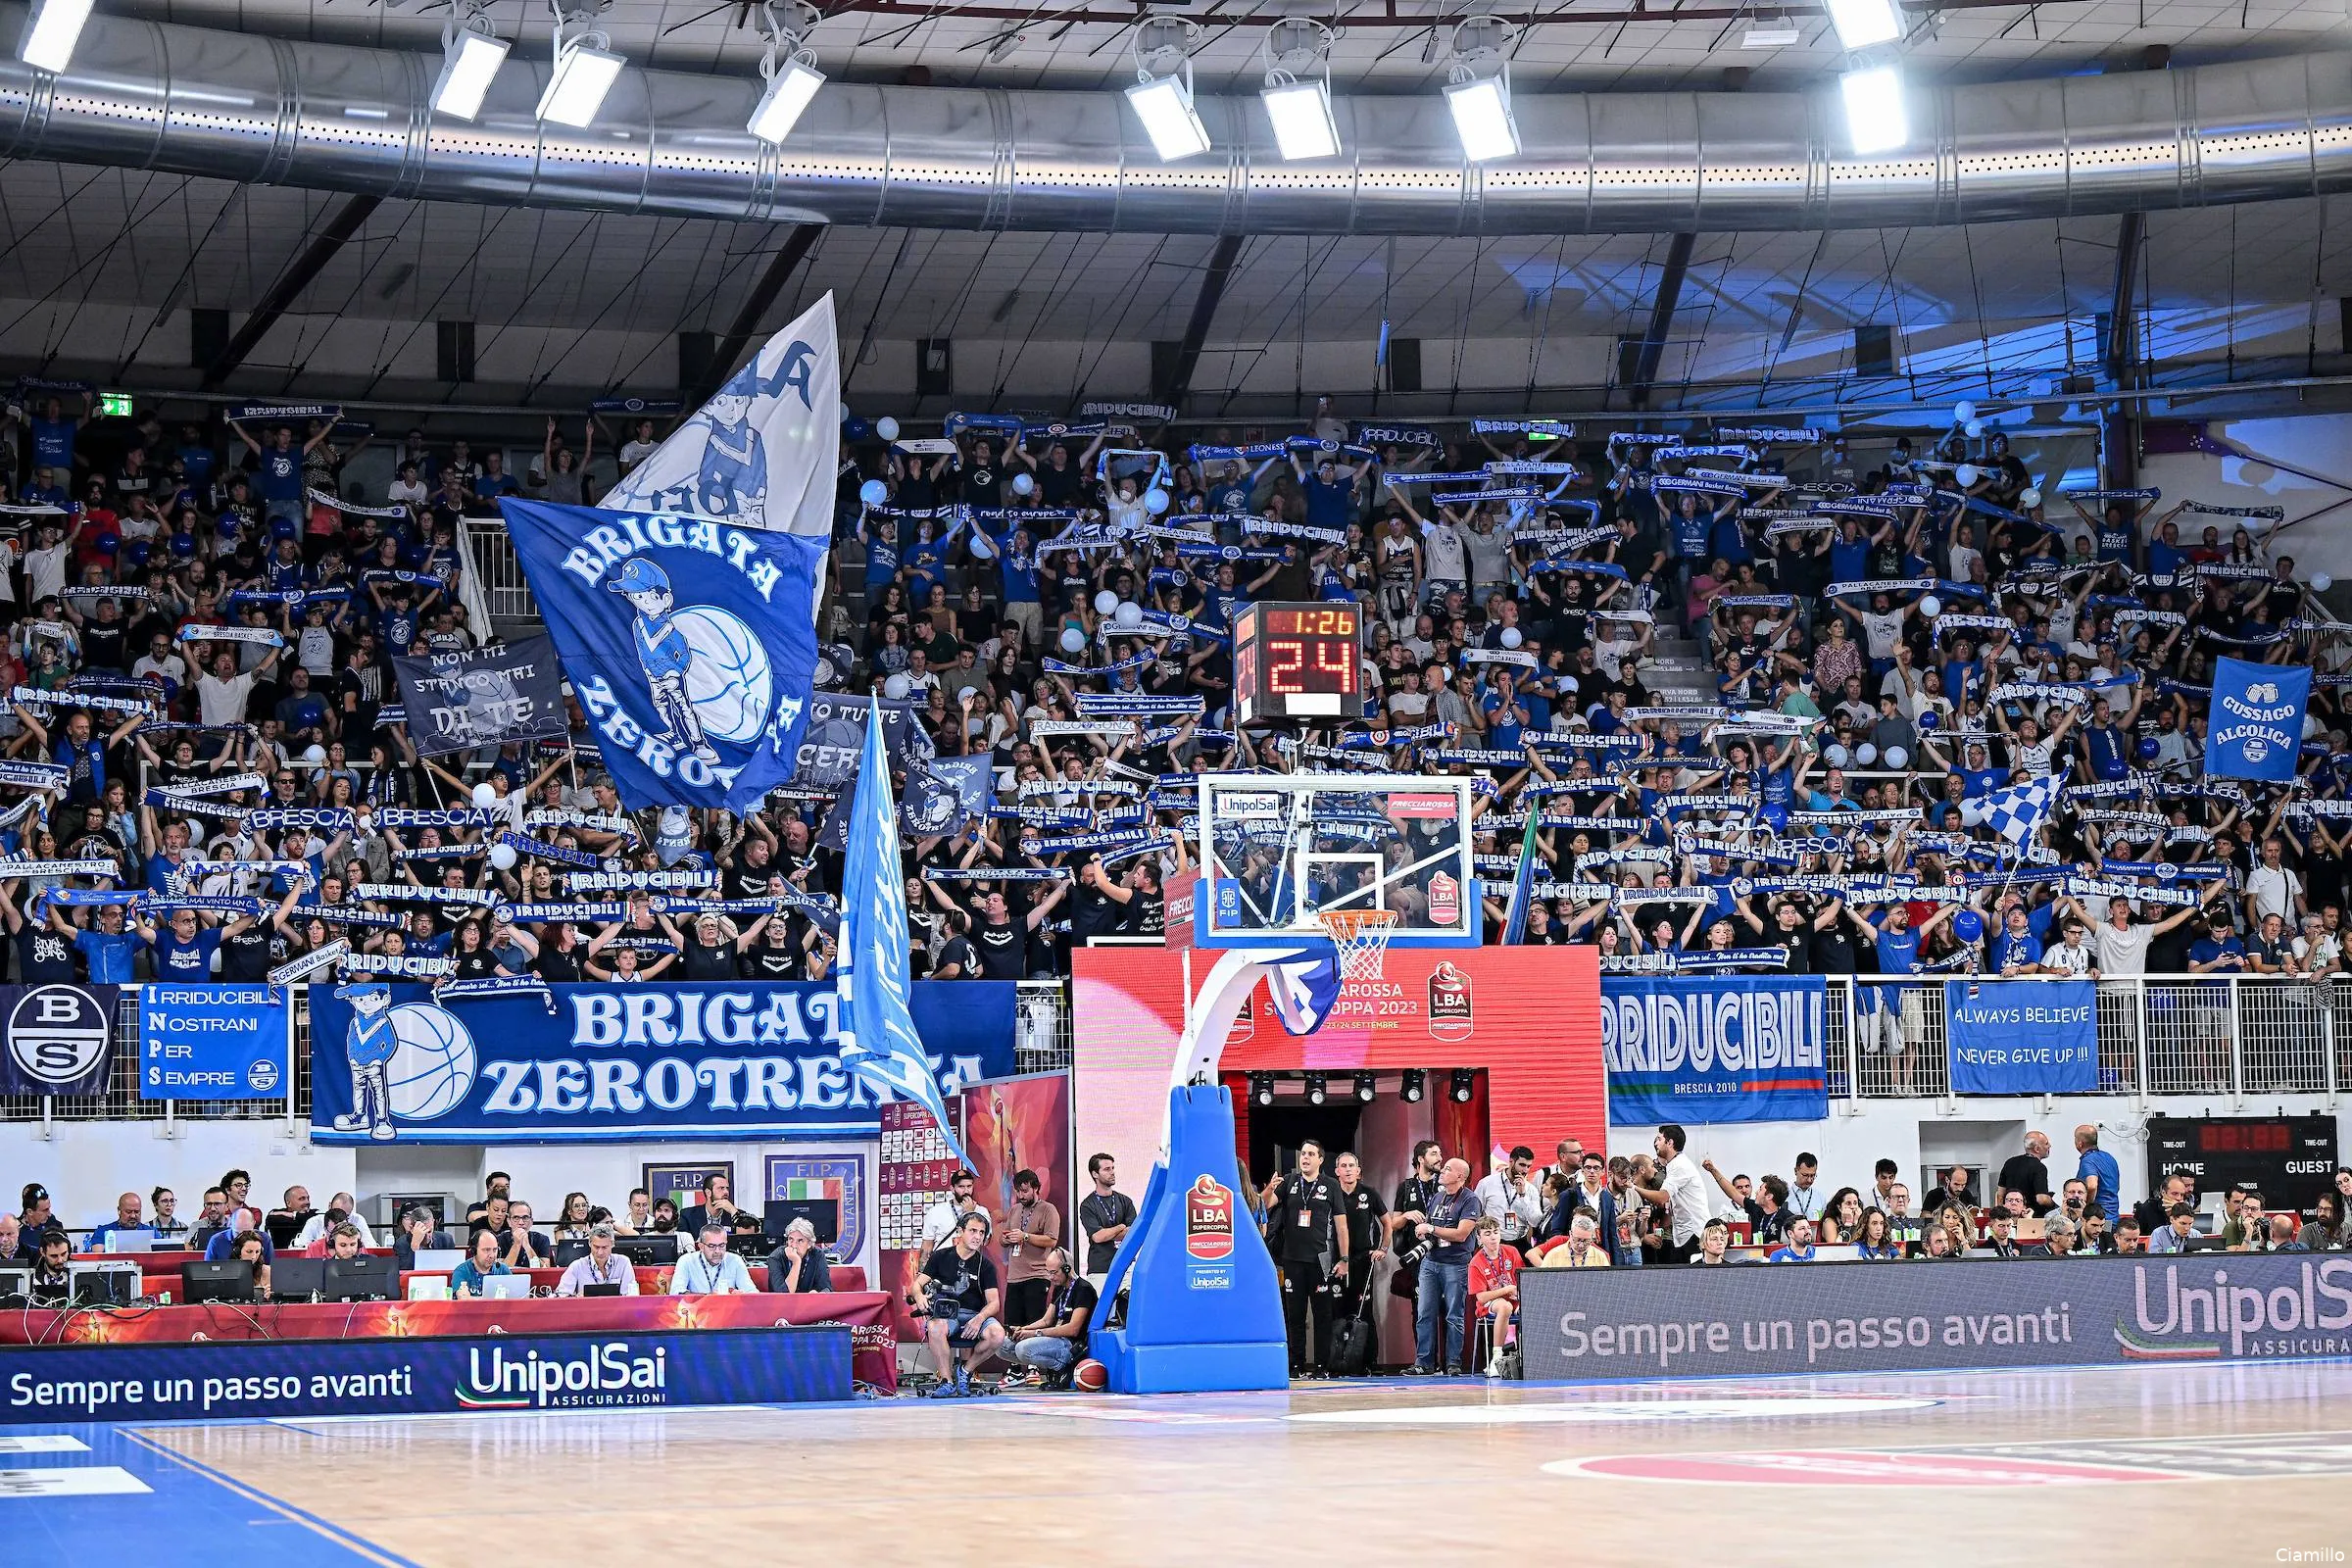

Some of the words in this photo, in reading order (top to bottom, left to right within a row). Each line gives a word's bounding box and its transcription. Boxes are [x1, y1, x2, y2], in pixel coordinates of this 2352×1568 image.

[1671, 478, 1704, 488] GERMANI
[1021, 511, 1056, 519] europe
[562, 515, 783, 604] BRIGATA
[1324, 575, 1342, 585] ITAL
[1295, 612, 1353, 634] 1:26
[431, 650, 474, 666] NON
[481, 645, 507, 659] MI
[1271, 642, 1350, 693] 24
[414, 673, 489, 692] STANCO
[496, 664, 536, 683] MAI
[430, 706, 472, 735] DI
[485, 697, 533, 726] TE
[2223, 696, 2296, 723] GUSSAGO
[1544, 733, 1638, 746] IRRIDUCIBILI
[2216, 724, 2294, 752] ALCOLICA
[1441, 749, 1526, 761] IRRIDUCIBILI
[168, 773, 258, 790] PALLACANESTRO
[191, 783, 236, 794] BRESCIA
[1221, 797, 1276, 815] UnipolSai
[1391, 800, 1453, 808] FRECCIAROSSA
[252, 808, 357, 829] BRESCIA
[383, 808, 487, 827] BRESCIA
[502, 832, 598, 868] BRESCIA
[1699, 838, 1794, 860] IRRIDUCIBILI
[7, 860, 107, 870] PALLACANESTRO
[570, 870, 714, 890] IRRIDUCIBILI
[1433, 893, 1454, 902] LBA
[1624, 886, 1705, 901] IRRIDUCIBILI
[2068, 879, 2199, 906] IRRIDUCIBILI
[515, 903, 620, 915] IRRIDUCIBILI
[278, 957, 316, 981] GERMANI
[149, 986, 275, 1005] IRRIDUCIBIL
[1435, 993, 1468, 1007] LBA
[36, 995, 80, 1022] B
[1380, 1001, 1418, 1015] 2023
[1955, 1008, 2020, 1023] ALWAYS
[2026, 1006, 2090, 1023] BELIEVE
[149, 1012, 258, 1032] NOSTRANI
[570, 992, 840, 1047] BRIGAT
[1600, 991, 1823, 1072] RRIDUCIBILI
[36, 1043, 79, 1068] S
[149, 1039, 193, 1058] PER
[1957, 1048, 2007, 1064] NEVER
[2012, 1048, 2050, 1063] GIVE
[2055, 1048, 2073, 1062] UP
[149, 1066, 235, 1086] SEMPRE
[1675, 1083, 1714, 1094] BRESCIA
[1716, 1082, 1737, 1093] 2010
[796, 1163, 833, 1176] F.I.P.
[2163, 1163, 2204, 1175] HOME
[2286, 1161, 2333, 1173] GUEST
[672, 1174, 704, 1187] F.I.P.
[1192, 1208, 1228, 1223] LBA
[1193, 1276, 1229, 1289] UnipolSai
[2133, 1259, 2352, 1356] UnipolS
[871, 1335, 896, 1349] 2023
[1561, 1311, 1730, 1367] Sempre
[1742, 1315, 1792, 1350] un
[1807, 1311, 1931, 1362] passo
[1943, 1301, 2073, 1346] avanti
[2250, 1339, 2352, 1355] ASSICURA
[469, 1343, 666, 1407] UnipolSai
[11, 1373, 146, 1413] Sempre
[152, 1376, 193, 1403] un
[203, 1371, 298, 1410] passo
[310, 1365, 413, 1398] avanti
[552, 1393, 667, 1407] ASSICURAZIONI
